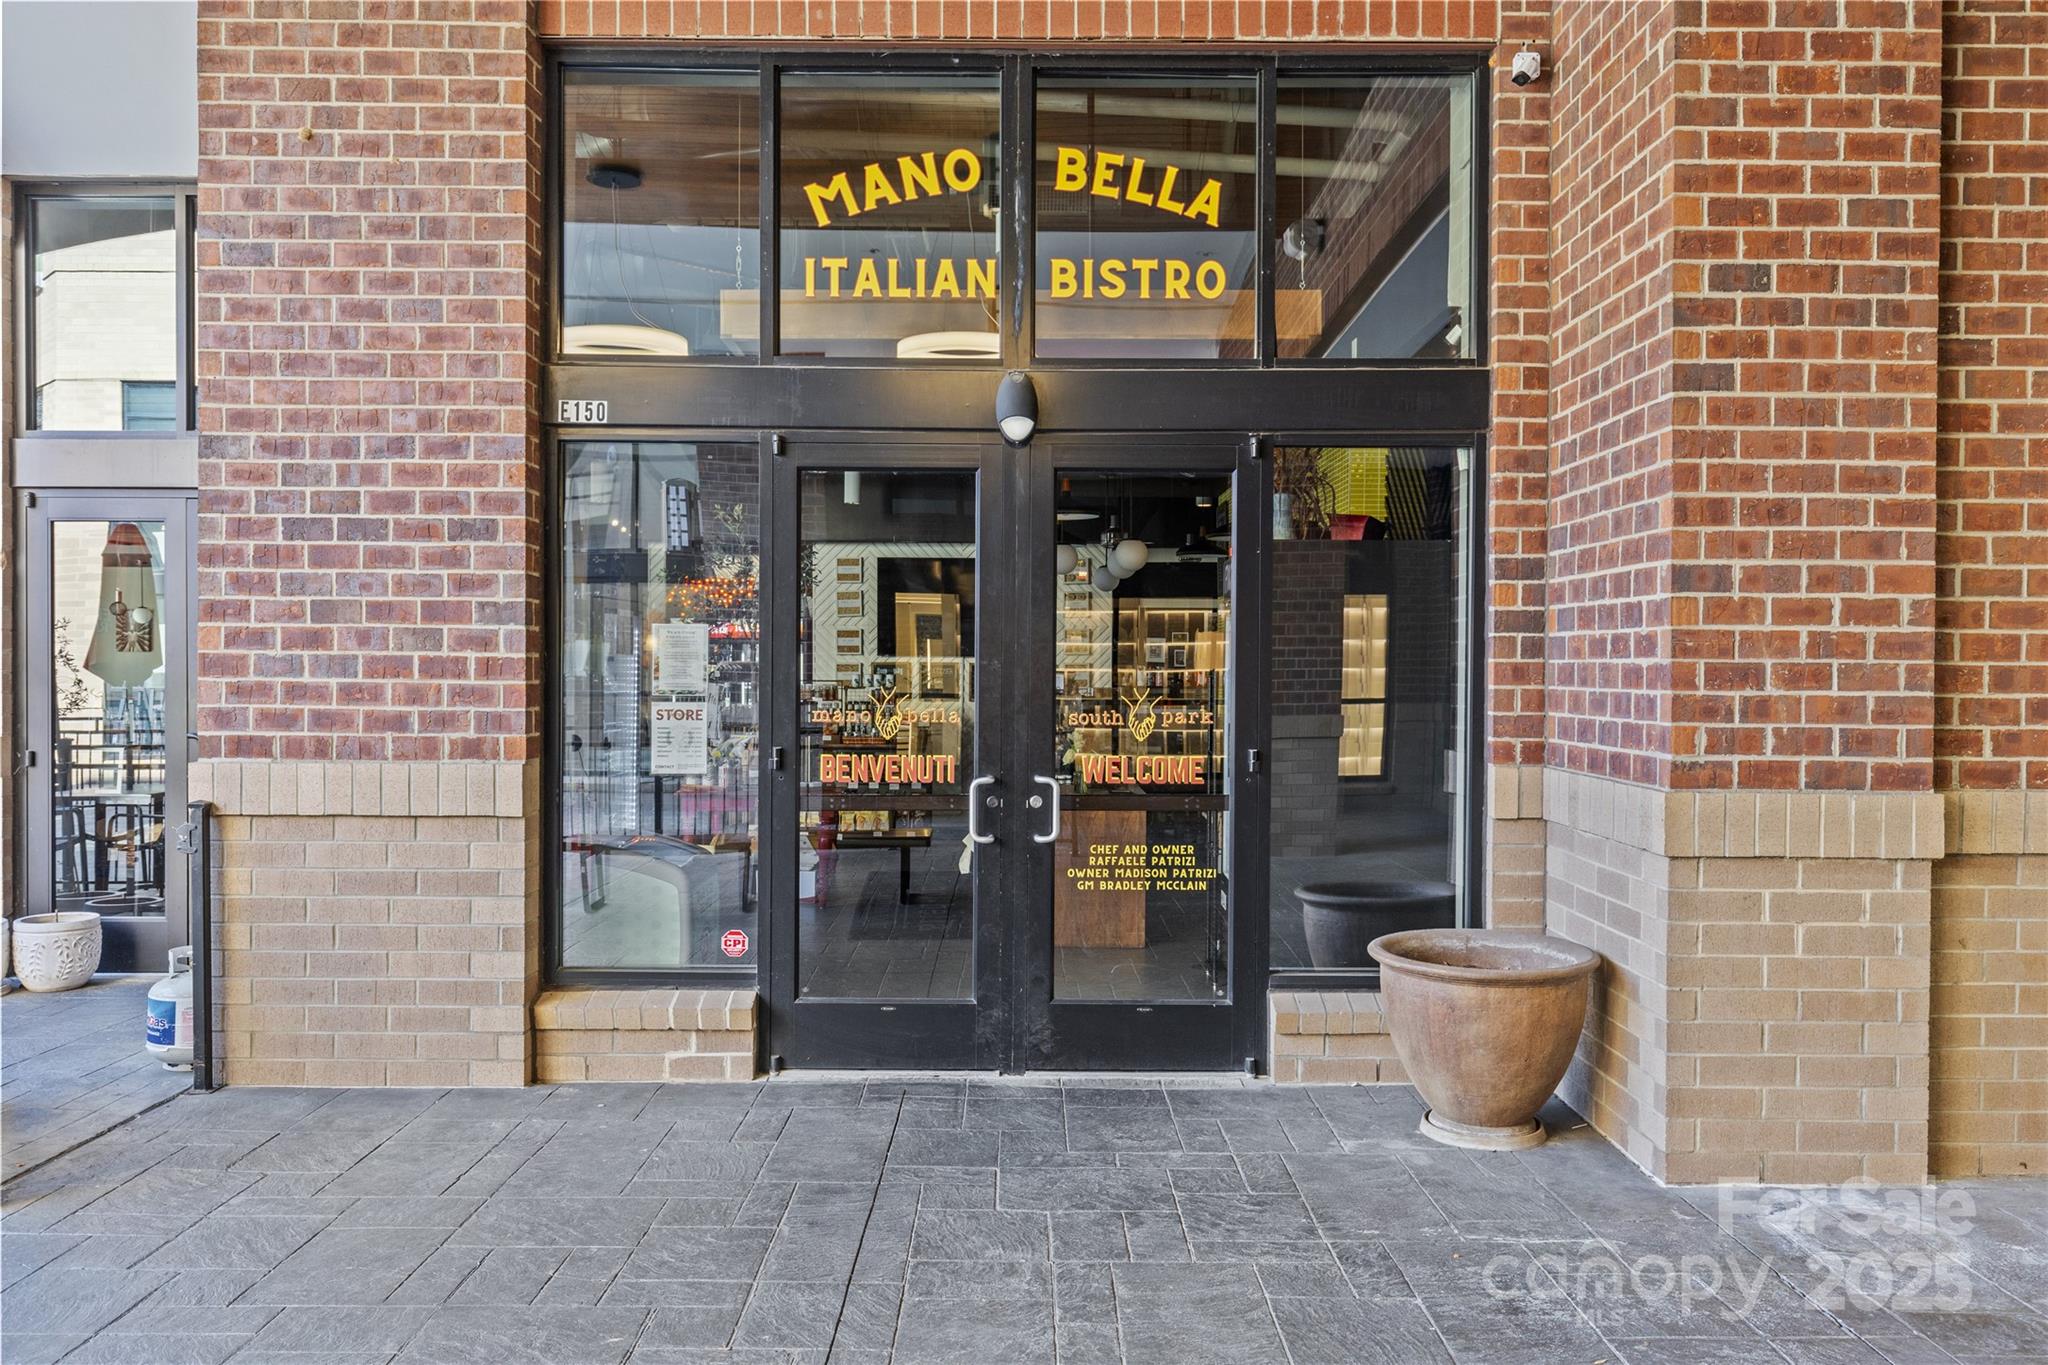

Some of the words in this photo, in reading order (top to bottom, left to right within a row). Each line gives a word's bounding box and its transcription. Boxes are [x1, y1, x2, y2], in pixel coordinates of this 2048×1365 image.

[803, 148, 981, 227] MANO
[1055, 146, 1222, 228] BELLA
[804, 257, 996, 298] ITALIAN
[1050, 258, 1226, 300] BISTRO
[561, 401, 606, 422] E150
[656, 708, 704, 721] STORE
[811, 709, 871, 723] mano
[907, 707, 961, 723] bella
[1068, 709, 1125, 726] south
[1161, 708, 1215, 727] park
[820, 753, 956, 784] BENVENUTI
[1081, 754, 1205, 785] WELCOME
[1089, 845, 1119, 854] CHEF
[1124, 845, 1148, 854] AND
[1152, 845, 1195, 854] OWNER
[1089, 857, 1146, 866] RAFFAELE
[1151, 857, 1196, 866] PATRIZI
[1067, 868, 1109, 878] OWNER
[1115, 868, 1168, 878] MADISON
[1173, 868, 1217, 878] PATRIZI
[1077, 881, 1094, 890] GM
[1099, 881, 1151, 890] BRADLEY
[1156, 881, 1207, 890] MCCLAIN
[724, 939, 746, 948] CPI
